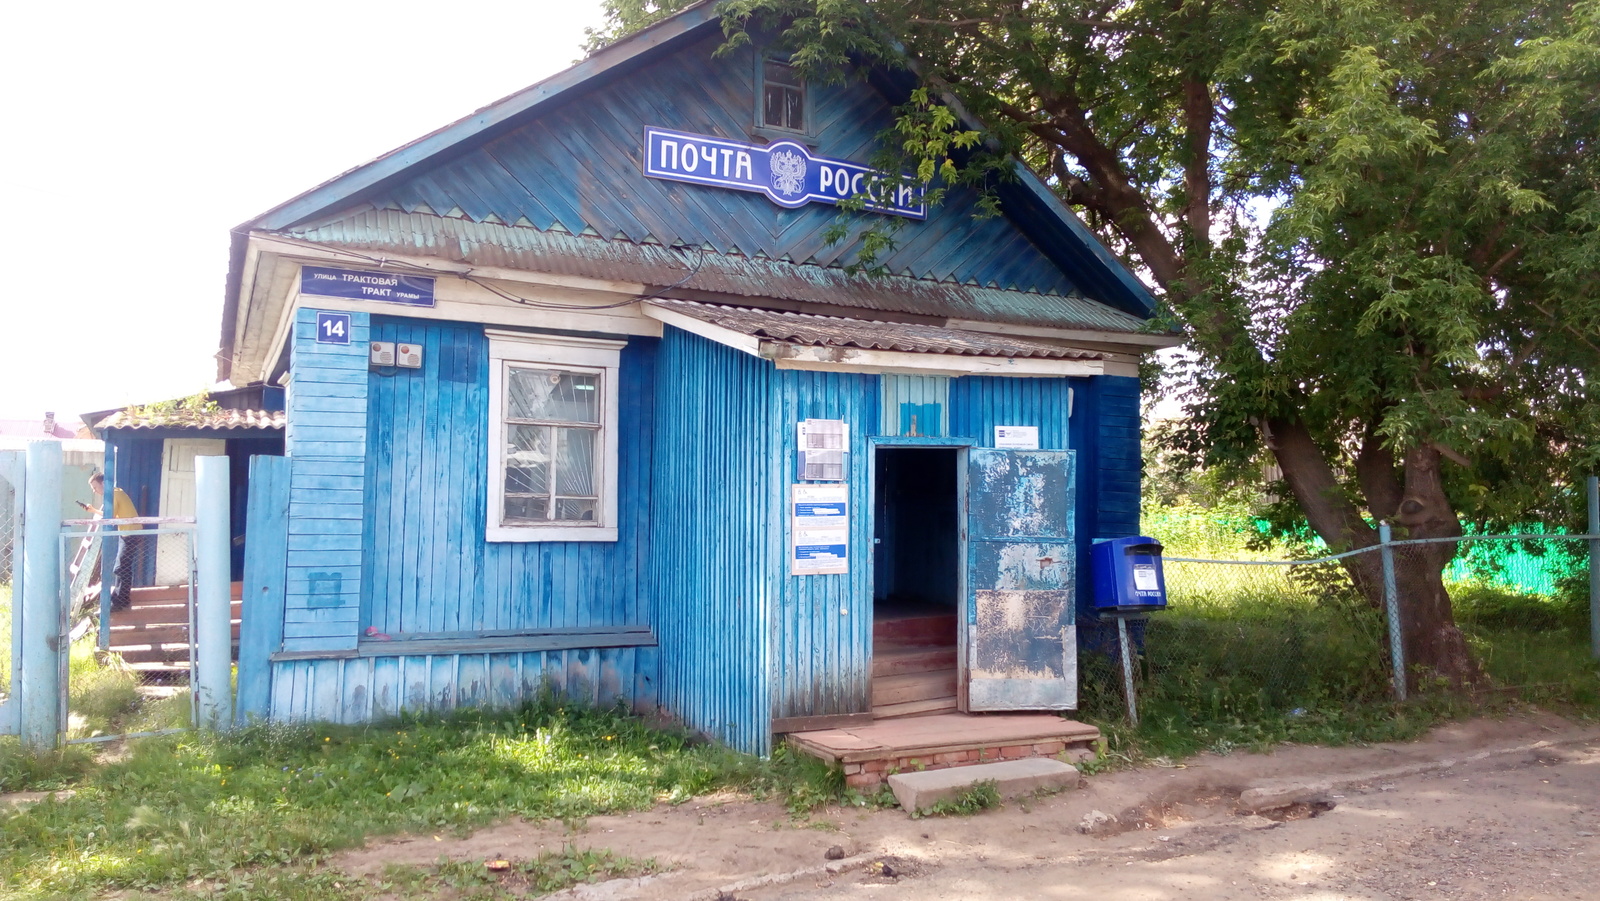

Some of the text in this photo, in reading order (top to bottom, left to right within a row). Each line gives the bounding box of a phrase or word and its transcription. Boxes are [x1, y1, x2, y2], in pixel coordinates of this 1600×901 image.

[660, 140, 752, 180] ПОЧТА
[342, 274, 398, 286] ТРАКТОВАЯ
[362, 286, 392, 296] ТРАКТ
[322, 320, 345, 337] 14
